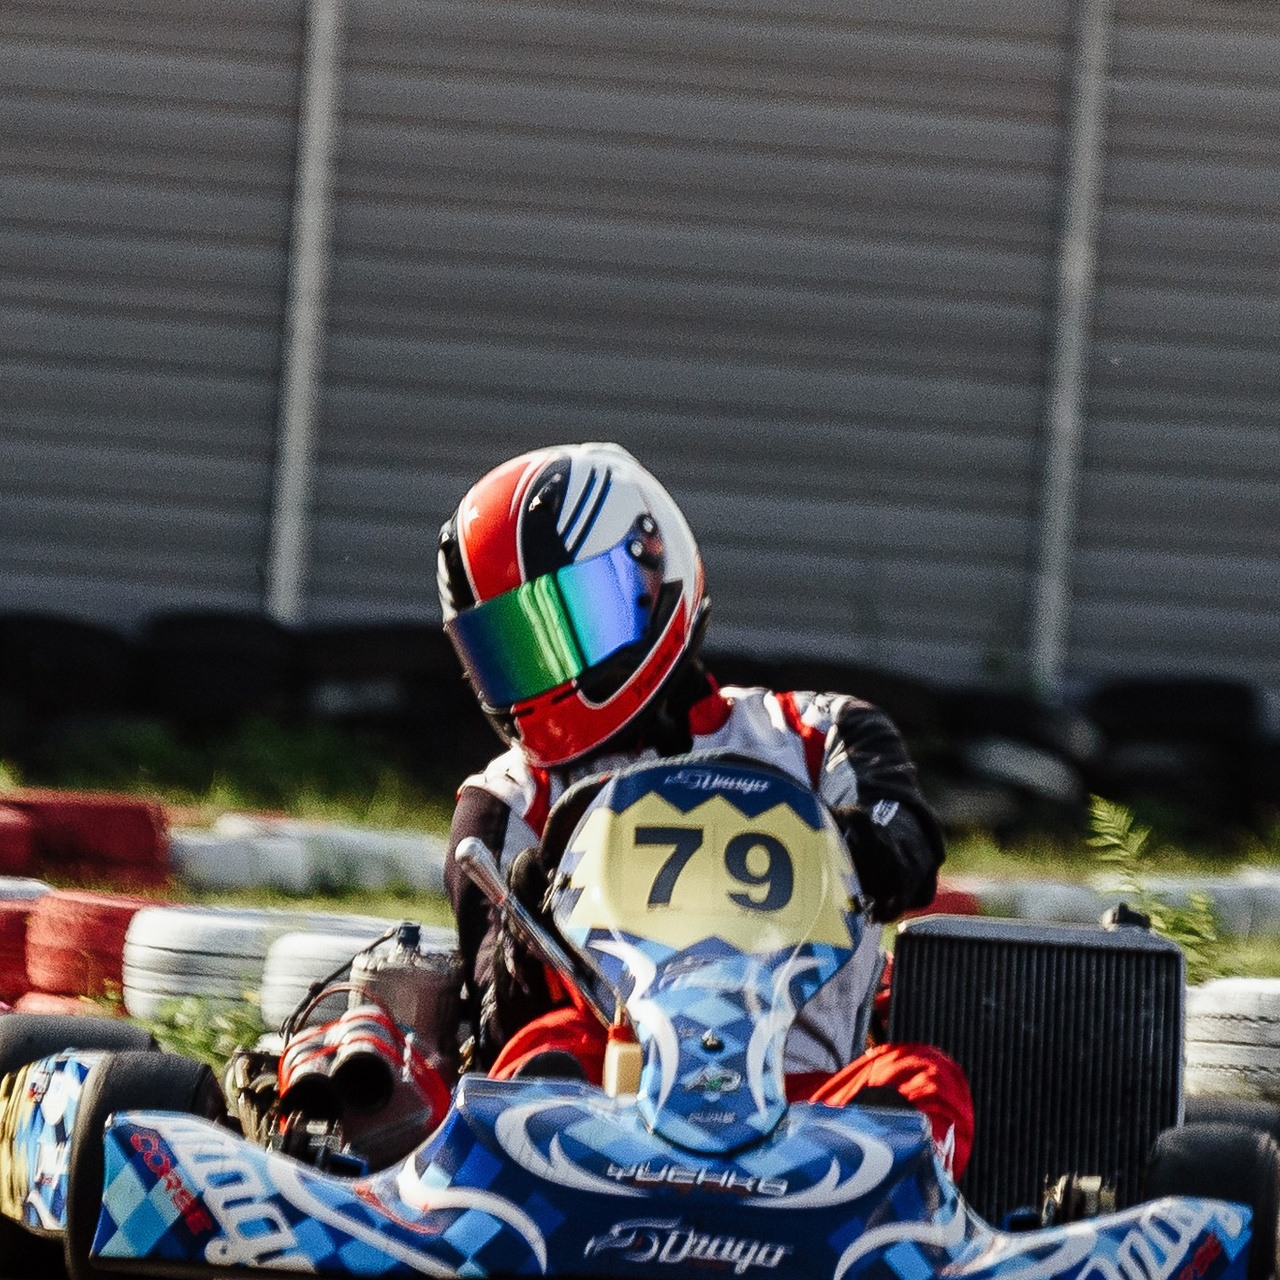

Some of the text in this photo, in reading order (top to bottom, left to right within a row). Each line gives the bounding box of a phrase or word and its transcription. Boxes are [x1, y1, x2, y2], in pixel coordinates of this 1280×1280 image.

[634, 826, 794, 912] 79
[130, 1132, 213, 1236] CORSE
[657, 1228, 793, 1275] Drago
